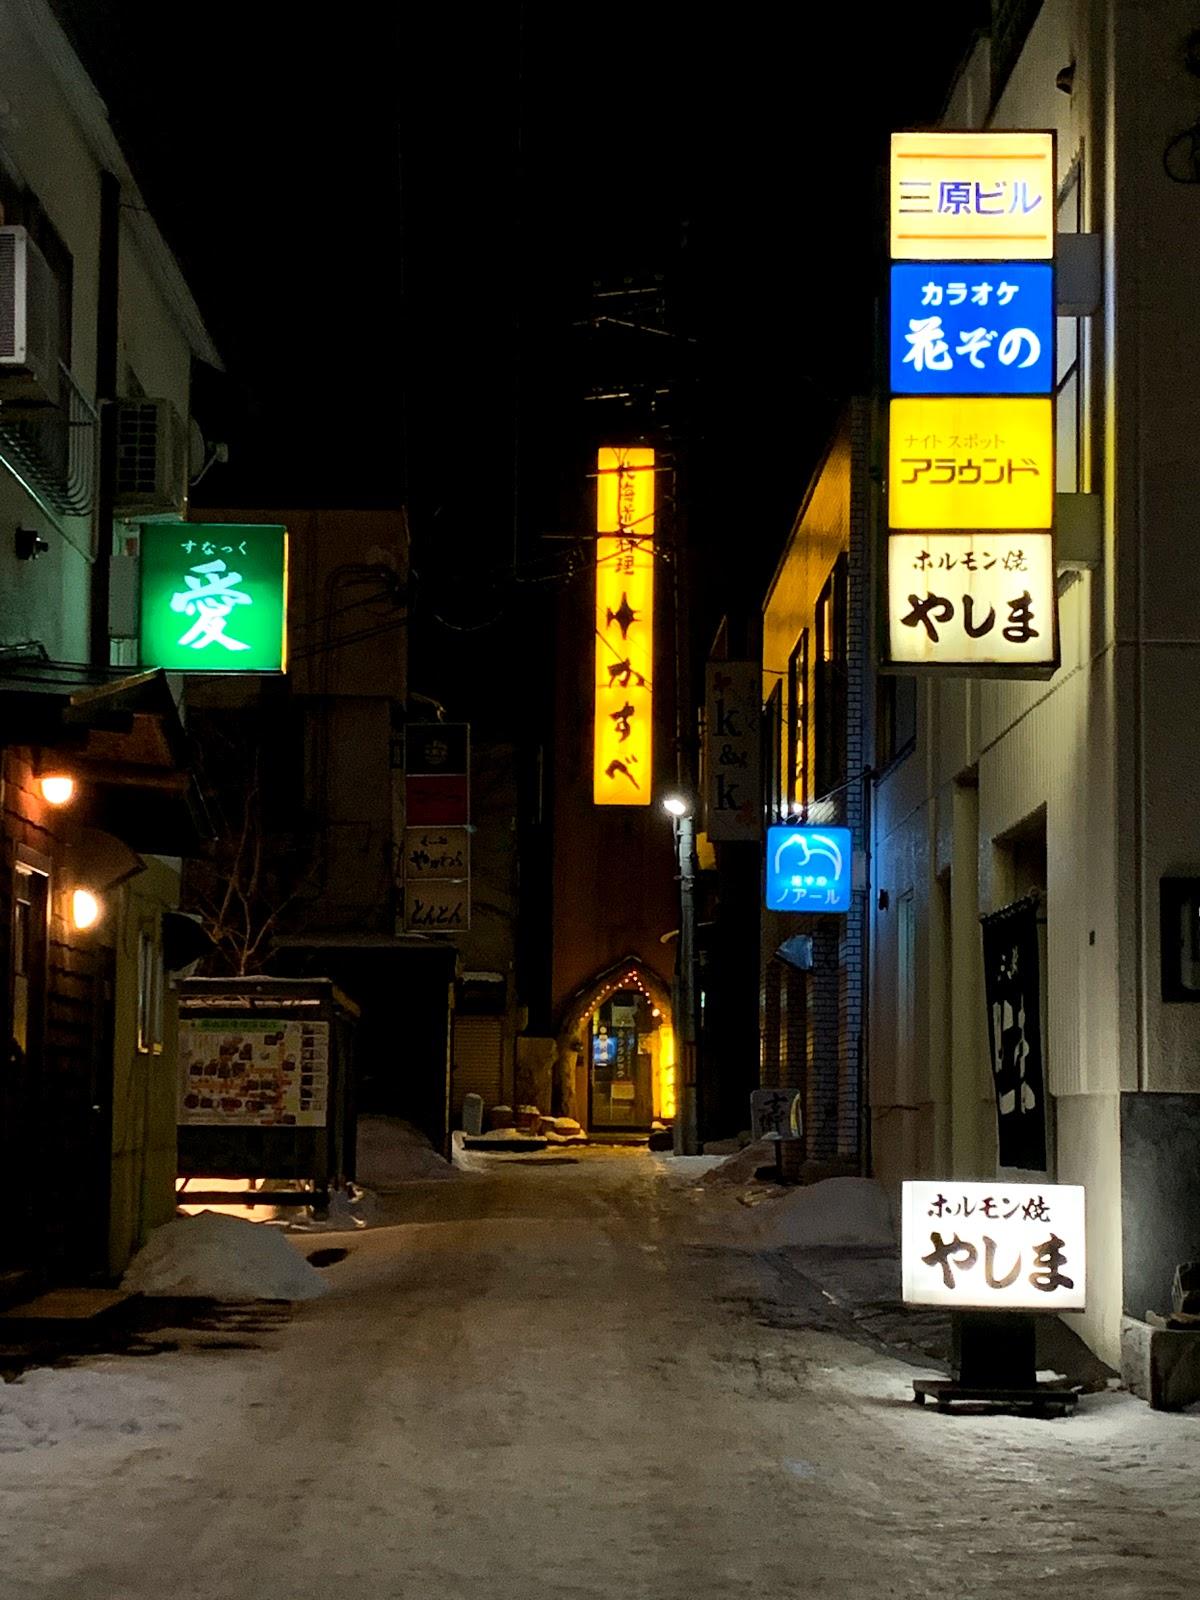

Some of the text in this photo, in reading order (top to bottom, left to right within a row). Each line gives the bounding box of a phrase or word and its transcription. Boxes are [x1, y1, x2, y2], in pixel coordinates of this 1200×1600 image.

[899, 181, 1042, 216] 三原ビル
[921, 281, 1020, 306] カラオケ
[902, 316, 1042, 372] 花ぞの
[904, 433, 1006, 449] ナイト スポット
[901, 458, 1040, 484] アラウンド
[181, 539, 247, 556] すなっく
[913, 549, 1029, 573] ホルモン焼
[169, 558, 253, 651] 愛
[900, 591, 1040, 644] やしま
[776, 888, 840, 905] ノアール
[927, 1193, 1052, 1222] ホルモン焼
[921, 1231, 1075, 1293] やしま
